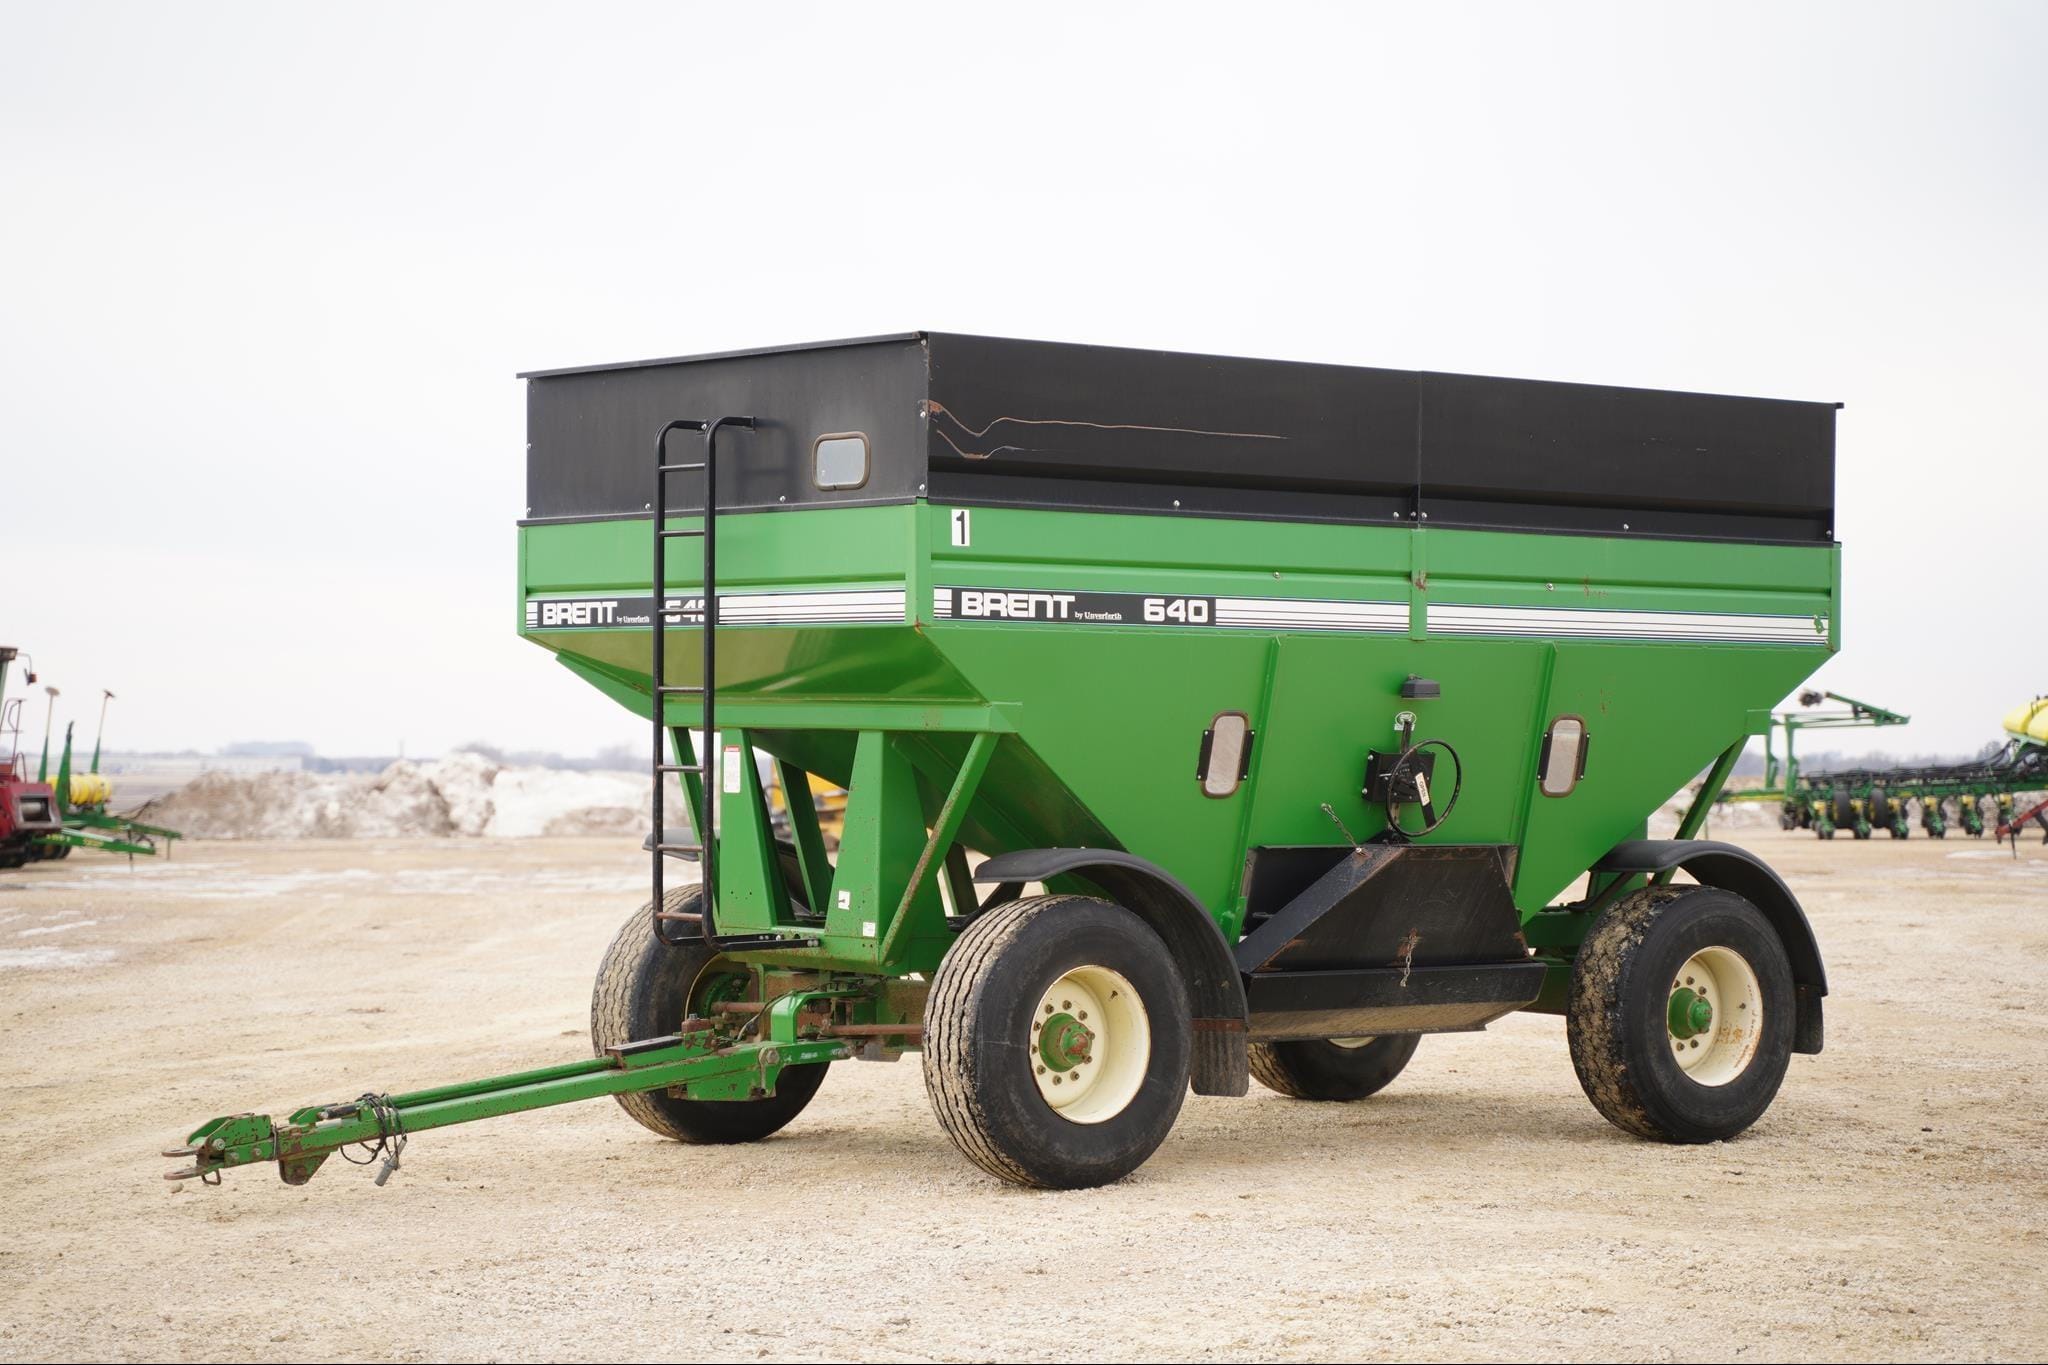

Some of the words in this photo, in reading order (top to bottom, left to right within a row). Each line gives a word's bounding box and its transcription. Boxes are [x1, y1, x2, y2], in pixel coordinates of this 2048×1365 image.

[956, 511, 965, 545] 1
[542, 601, 618, 625] BRENT
[665, 600, 705, 622] 64
[961, 591, 1075, 618] BRENT
[1075, 611, 1084, 620] by
[1143, 598, 1209, 623] 640
